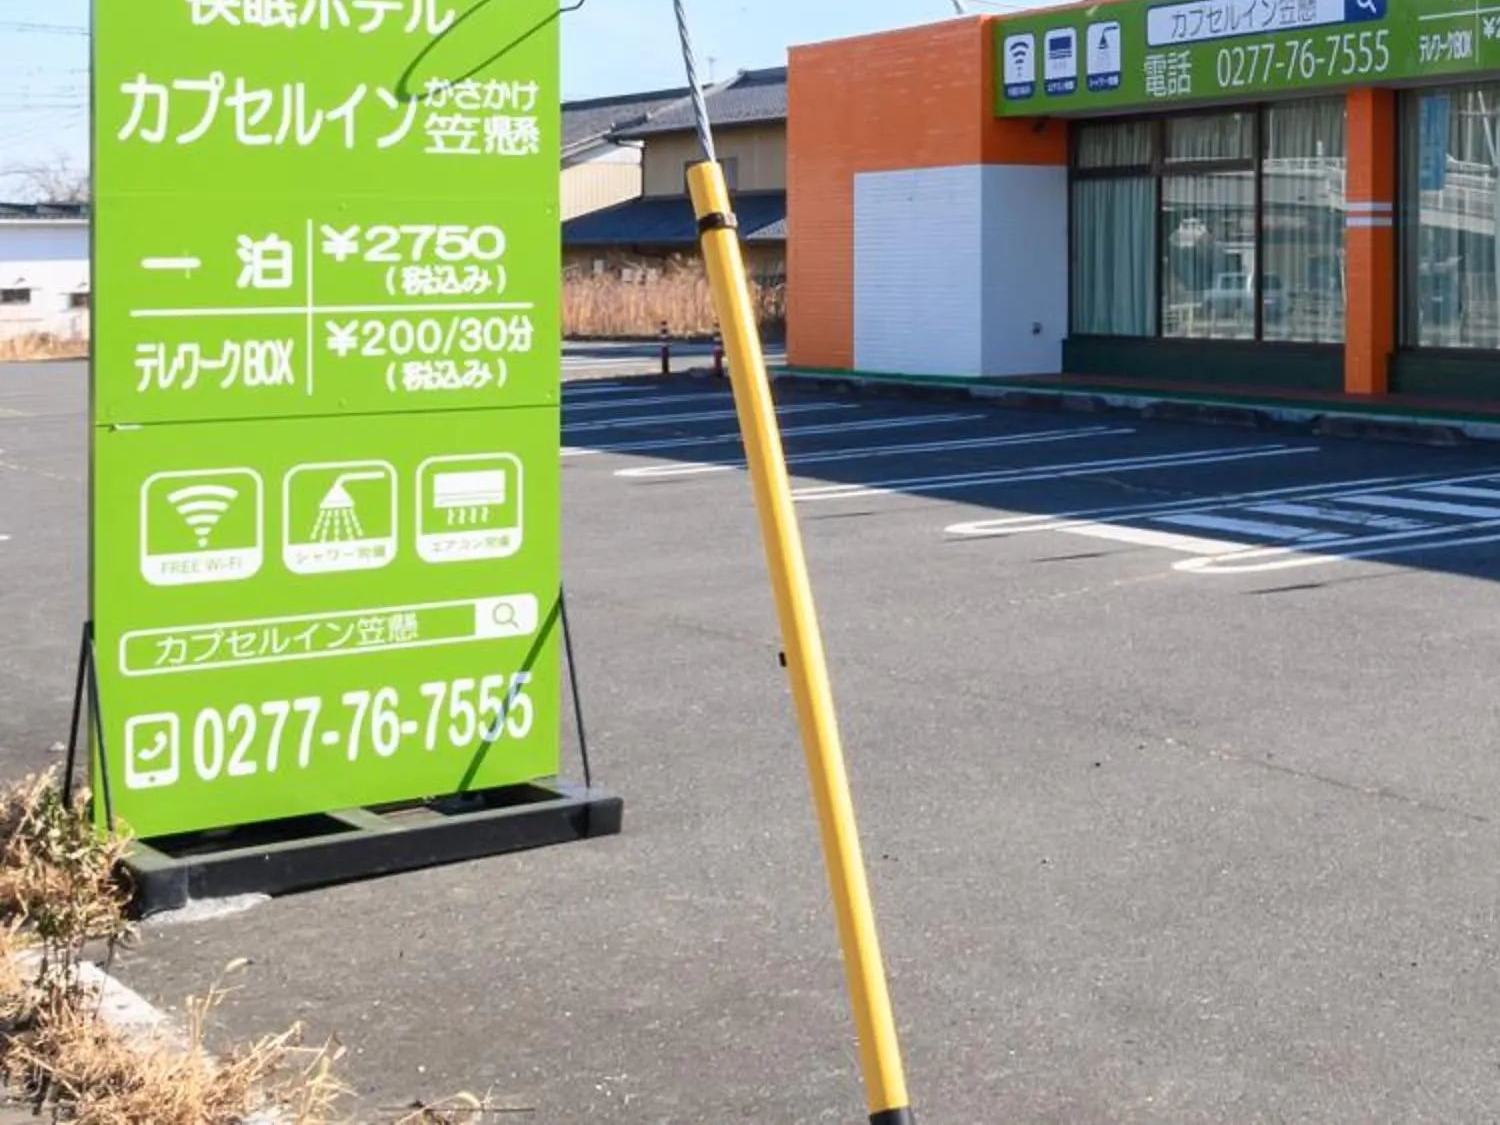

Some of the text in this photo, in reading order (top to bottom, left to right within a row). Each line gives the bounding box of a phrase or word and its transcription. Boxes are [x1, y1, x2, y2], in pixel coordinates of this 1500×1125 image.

[423, 76, 540, 112] かさかけ
[1144, 30, 1390, 97] 電話 0277-76-7555
[118, 71, 418, 150] カプセルイン
[192, 672, 534, 781] 0277-76-7555
